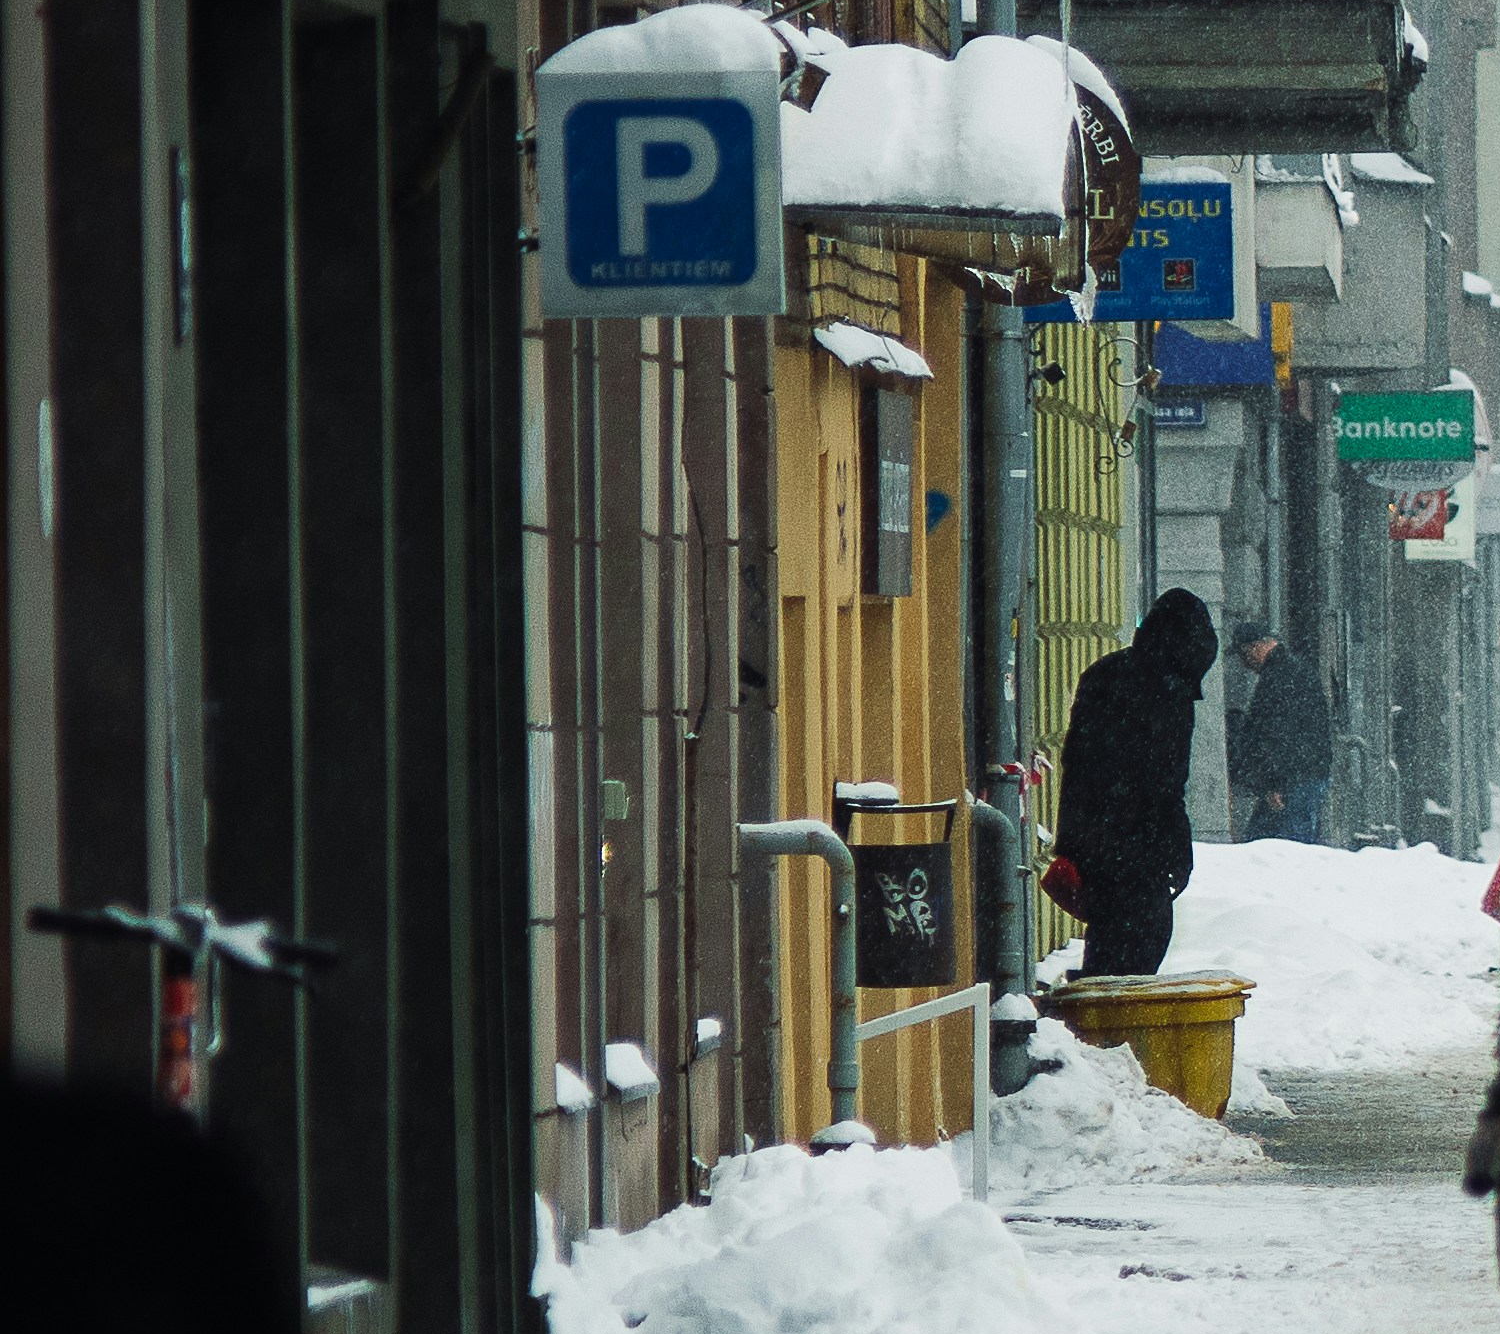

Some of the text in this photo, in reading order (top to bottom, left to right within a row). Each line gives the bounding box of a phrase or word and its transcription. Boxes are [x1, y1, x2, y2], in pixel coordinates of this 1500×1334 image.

[1078, 104, 1120, 165] ĒRBI
[615, 115, 720, 257] P
[590, 259, 733, 279] KLIENTIEM
